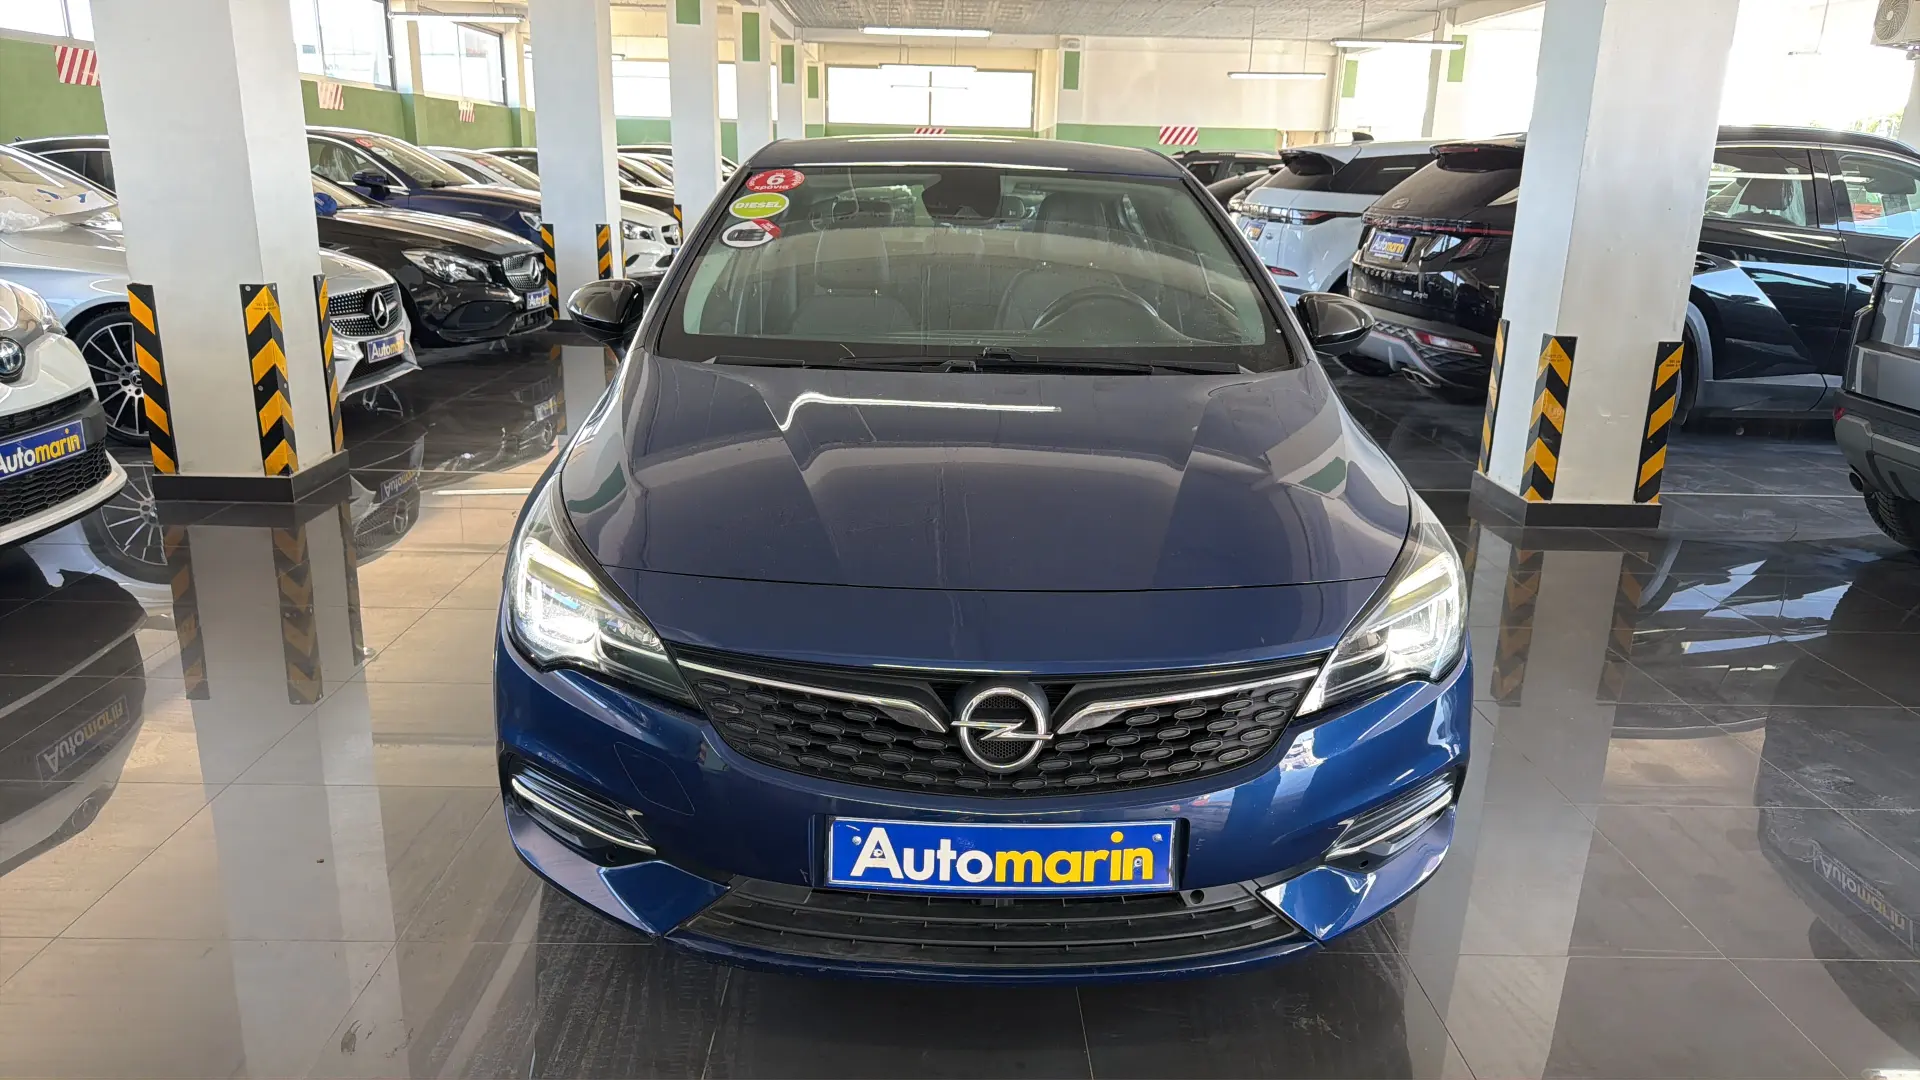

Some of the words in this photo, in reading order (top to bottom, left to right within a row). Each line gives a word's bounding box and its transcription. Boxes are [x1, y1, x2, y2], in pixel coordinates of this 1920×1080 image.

[766, 174, 786, 186] 6
[734, 201, 782, 209] DIESEL
[850, 827, 1154, 883] Automarin
